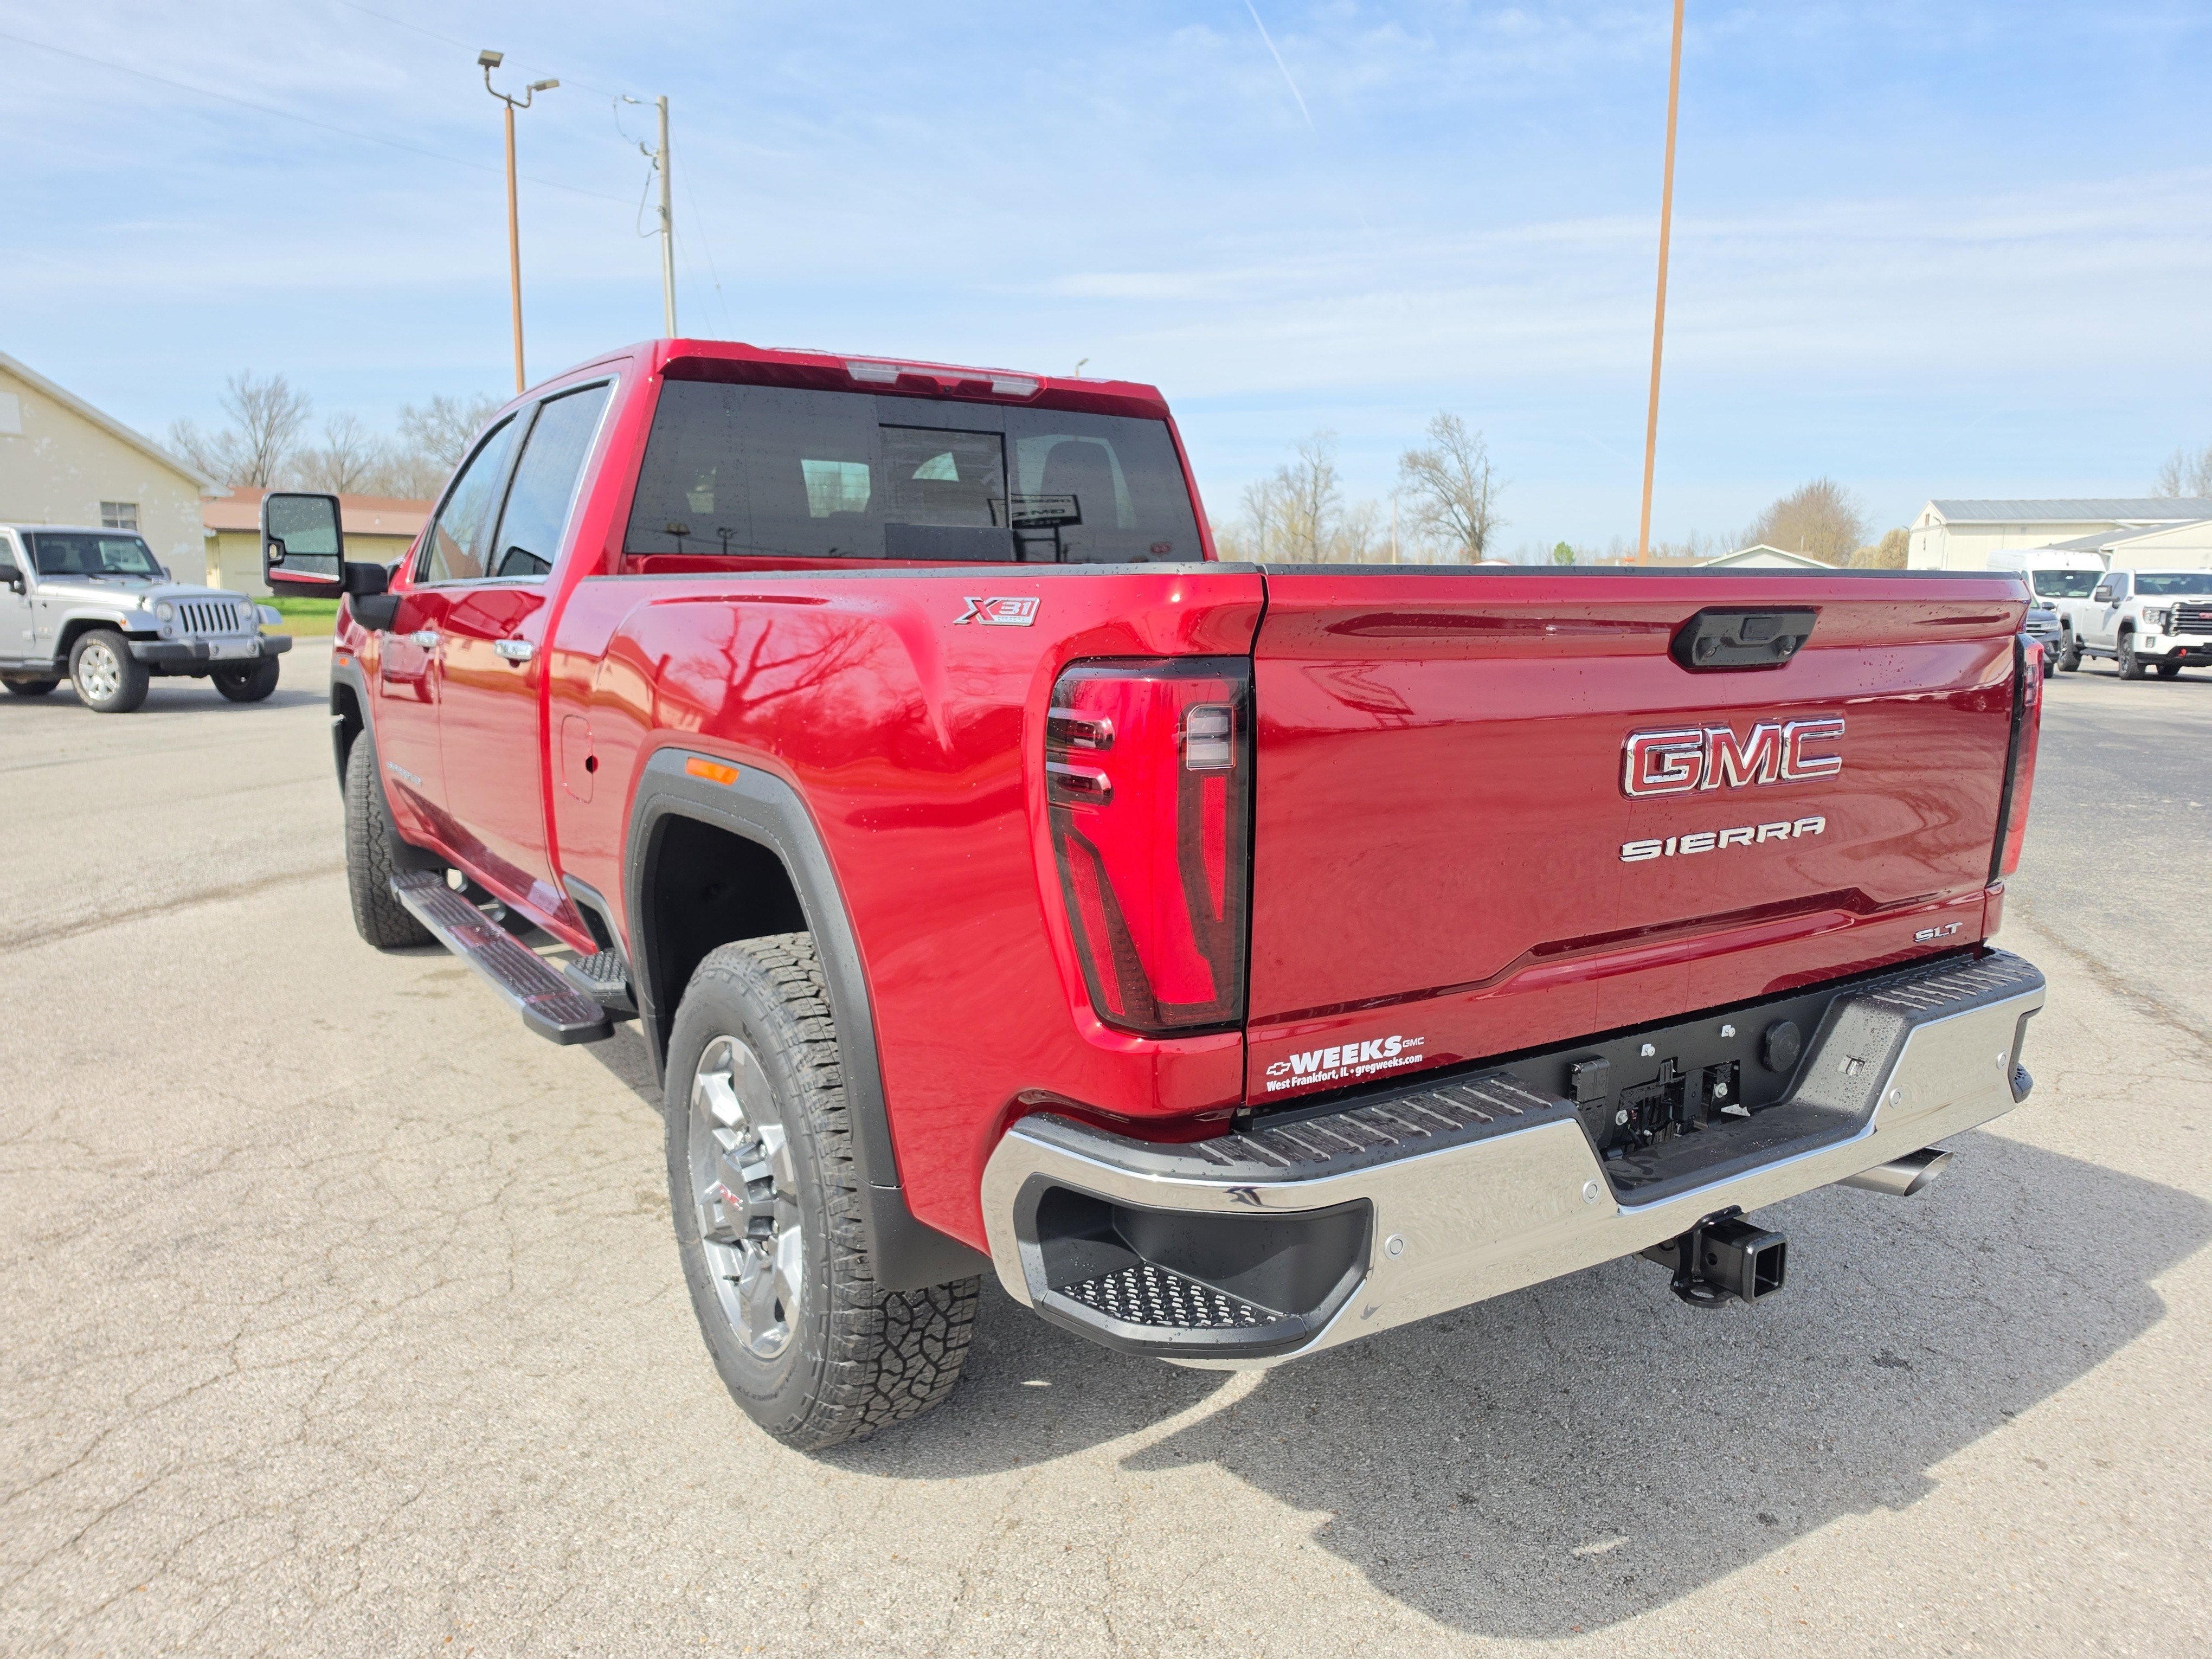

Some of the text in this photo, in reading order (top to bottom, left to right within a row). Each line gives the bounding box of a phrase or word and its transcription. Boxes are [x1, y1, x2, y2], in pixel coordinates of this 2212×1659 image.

[1625, 717, 1845, 796] GMC
[1620, 816, 1826, 863] SIERRA
[1914, 922, 1963, 943] SLT
[1266, 1054, 1423, 1092] West Frankfort, IL gregweeks.com
[1289, 1036, 1425, 1075] WEEKS GMC
